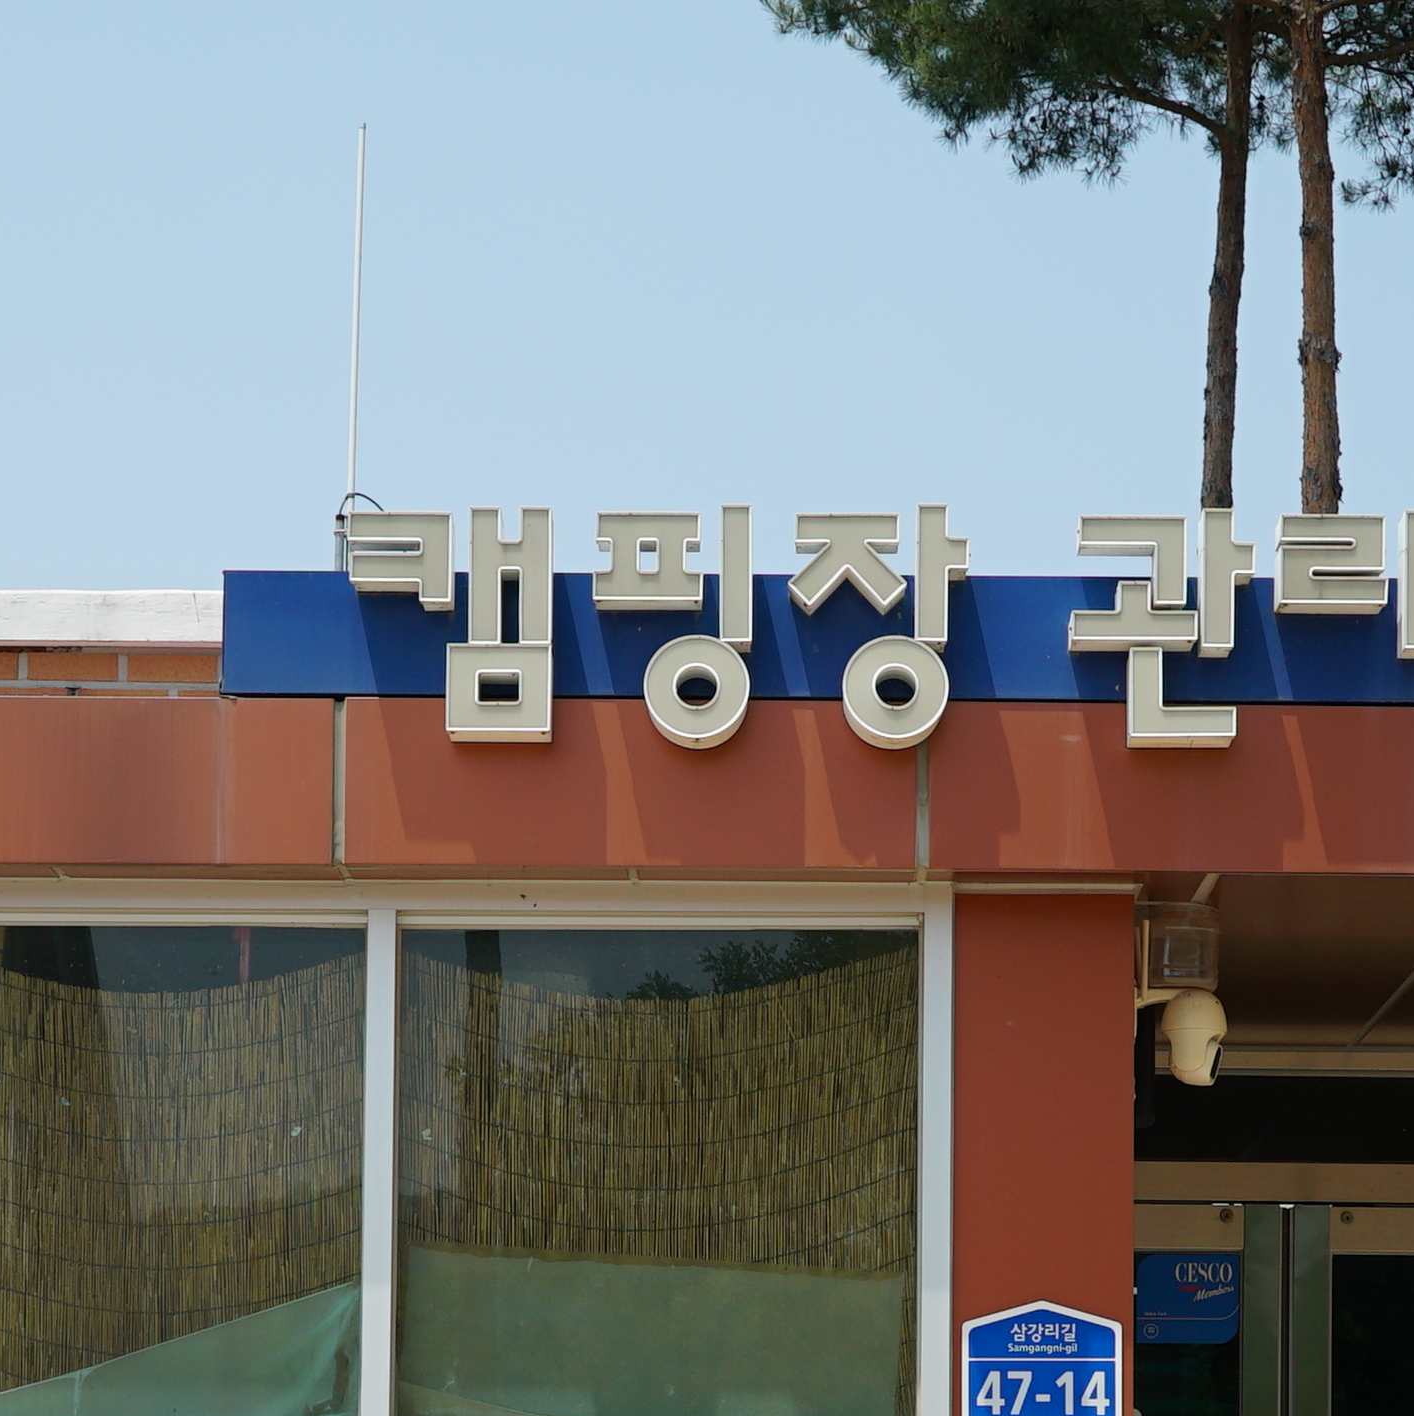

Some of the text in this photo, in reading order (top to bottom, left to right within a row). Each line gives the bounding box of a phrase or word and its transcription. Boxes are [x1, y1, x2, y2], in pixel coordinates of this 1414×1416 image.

[348, 503, 971, 750] 캠핑장
[1175, 1262, 1233, 1283] CESCO
[1010, 1323, 1077, 1344] 삼강리길
[1007, 1343, 1078, 1354] Samgangni-gil
[976, 1370, 1111, 1416] 47-14
